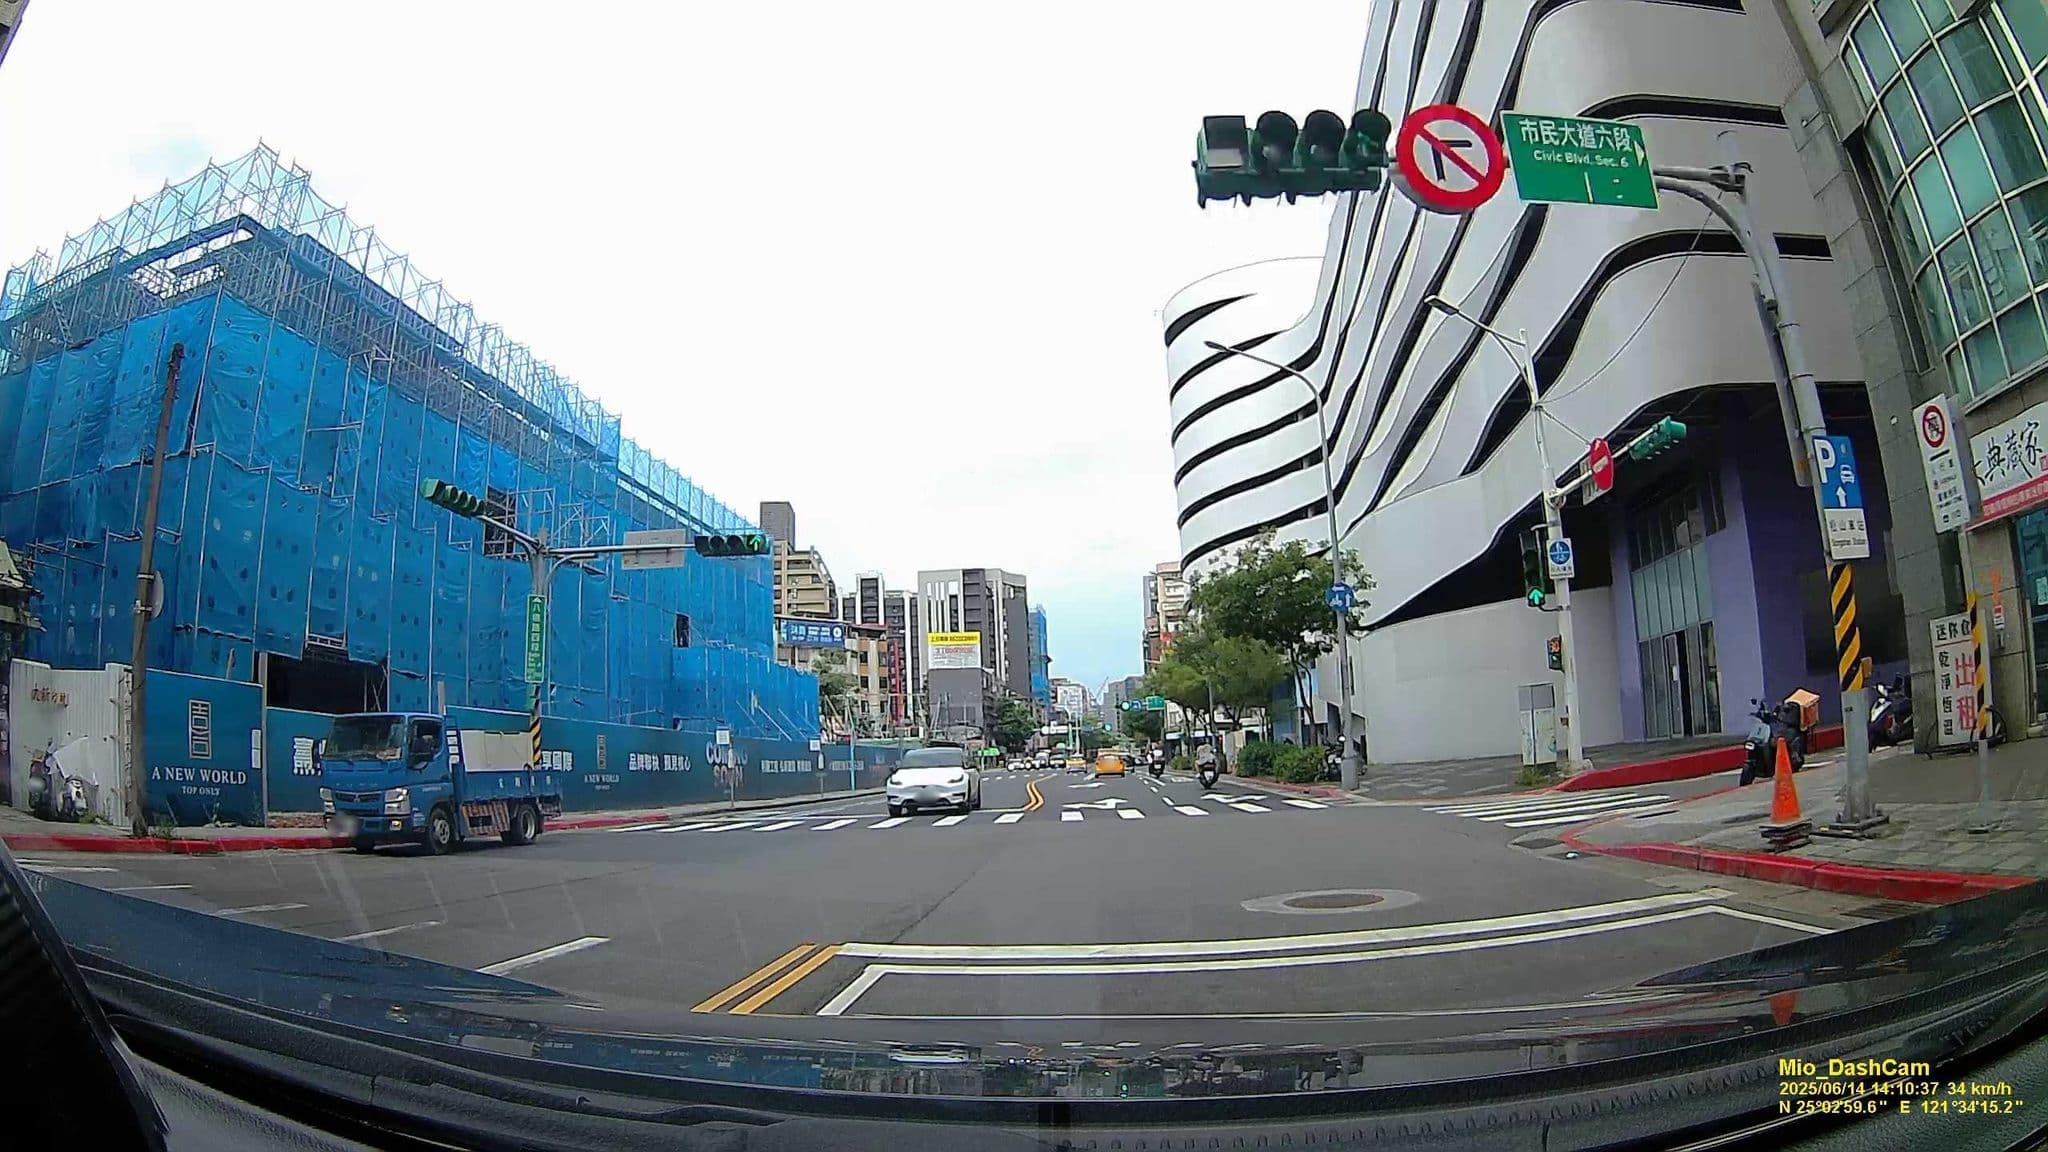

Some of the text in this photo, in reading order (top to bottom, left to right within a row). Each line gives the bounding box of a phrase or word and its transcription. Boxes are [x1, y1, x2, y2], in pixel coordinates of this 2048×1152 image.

[1519, 118, 1632, 152] 市民大道六段
[1533, 150, 1562, 163] Civic
[1565, 151, 1593, 165] Blvd.
[1620, 156, 1629, 168] 6
[1813, 439, 1836, 484] P
[1955, 652, 1976, 730] 出租
[151, 766, 247, 785] A NEW WORLD
[181, 785, 221, 797] TOP ONLY
